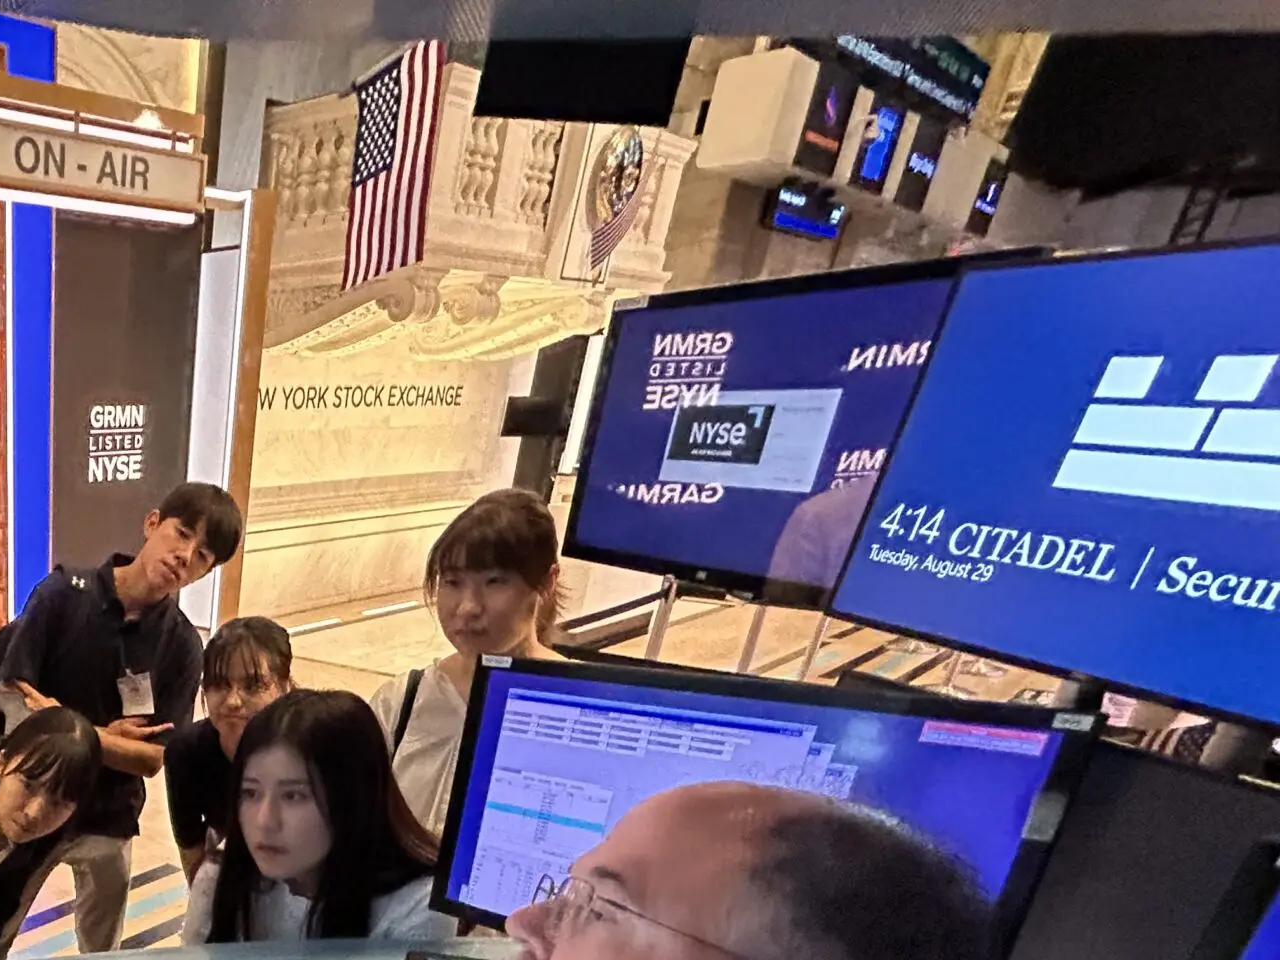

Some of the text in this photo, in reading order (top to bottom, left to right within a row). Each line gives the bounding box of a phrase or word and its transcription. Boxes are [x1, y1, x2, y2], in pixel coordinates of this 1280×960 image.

[14, 135, 66, 179] ON
[96, 150, 150, 191] AIR
[282, 386, 330, 410] YORK
[332, 385, 386, 408] STOCK
[387, 384, 464, 407] EXCHANGE
[90, 404, 144, 428] GRMN
[89, 434, 143, 450] LISTED
[88, 455, 143, 483] NYSE
[880, 502, 947, 545] 4:14
[868, 544, 995, 583] Tuesday, August 29
[948, 522, 1117, 582] CITADEL
